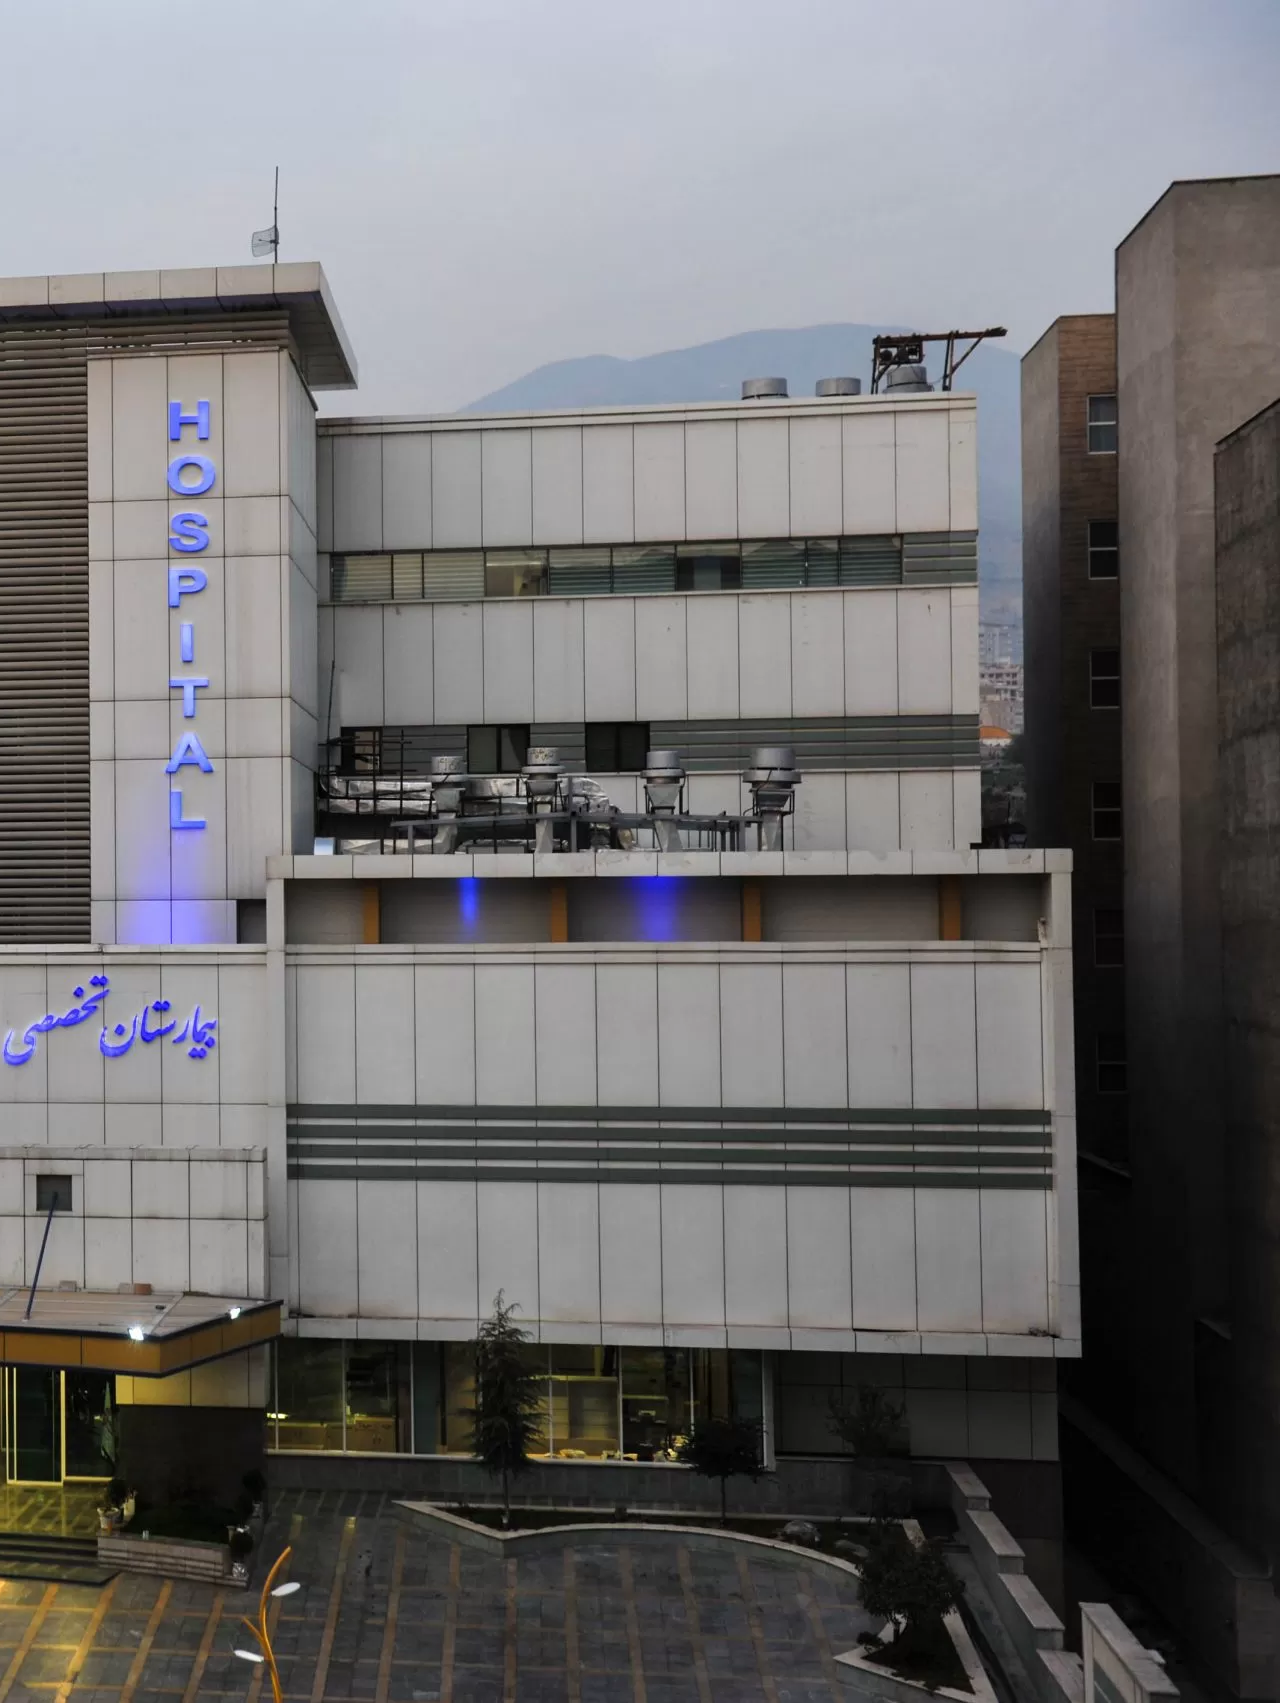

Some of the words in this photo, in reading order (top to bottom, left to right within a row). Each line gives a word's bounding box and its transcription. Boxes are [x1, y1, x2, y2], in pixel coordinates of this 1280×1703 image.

[165, 400, 216, 831] HOSPITAL
[2, 973, 110, 1067] تخصصی
[98, 1000, 218, 1059] بیمارستان
